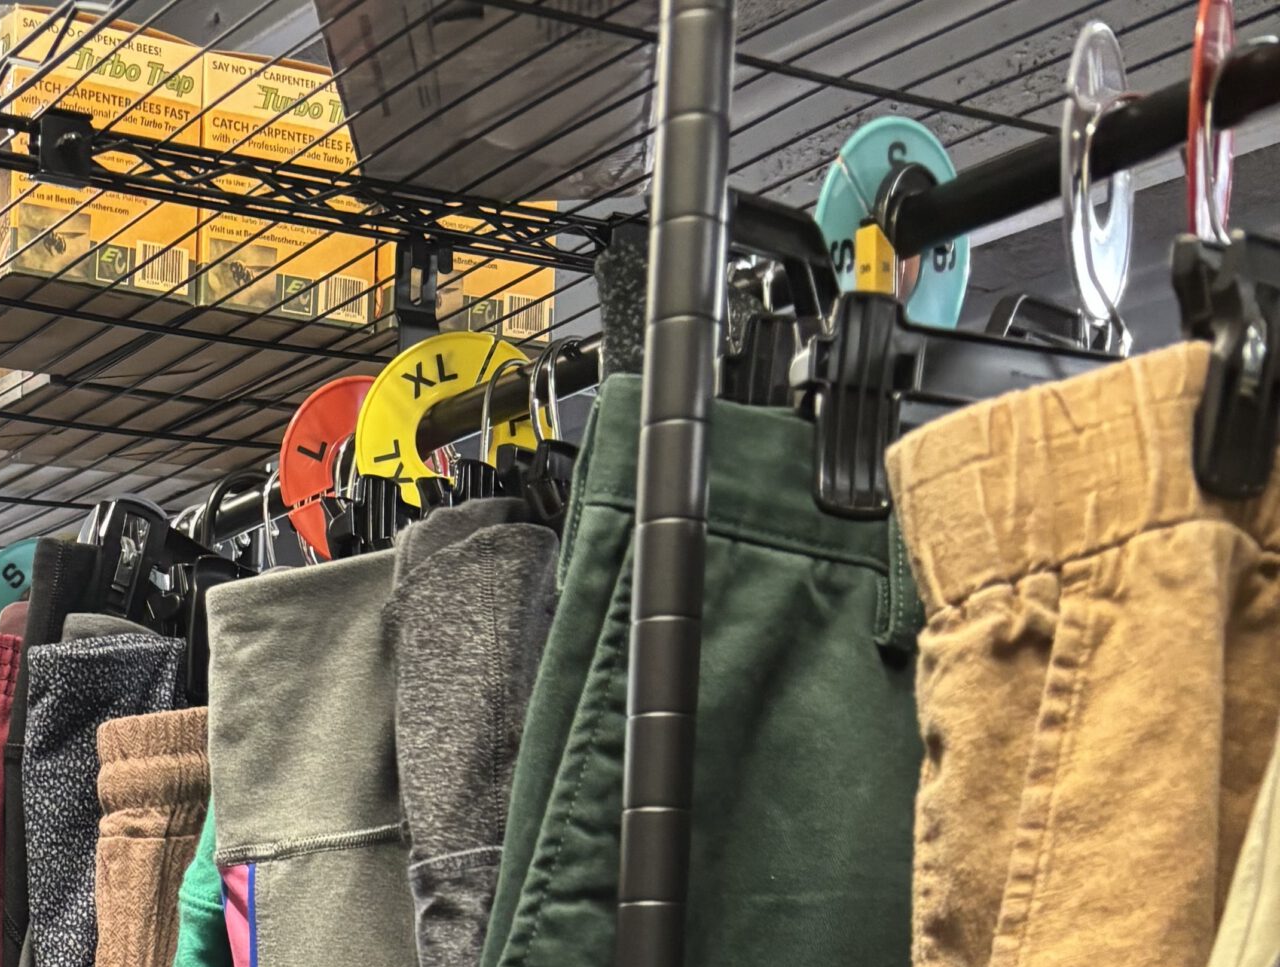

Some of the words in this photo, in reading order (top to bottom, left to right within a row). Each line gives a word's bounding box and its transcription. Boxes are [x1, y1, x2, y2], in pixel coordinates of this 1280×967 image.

[136, 42, 162, 57] BEES!
[76, 47, 142, 82] Turbo
[147, 61, 195, 97] Trap
[212, 60, 230, 72] SAY
[231, 64, 247, 76] NO
[263, 71, 316, 89] CARPENTER
[140, 116, 163, 129] Turbo
[164, 106, 191, 122] FAST
[212, 116, 249, 133] CATCH
[212, 133, 231, 143] with
[248, 140, 296, 155] Professional
[323, 152, 344, 165] Turbo
[209, 224, 226, 234] Visit
[401, 353, 459, 400] XL
[297, 440, 328, 462] L
[2, 562, 26, 590] S
